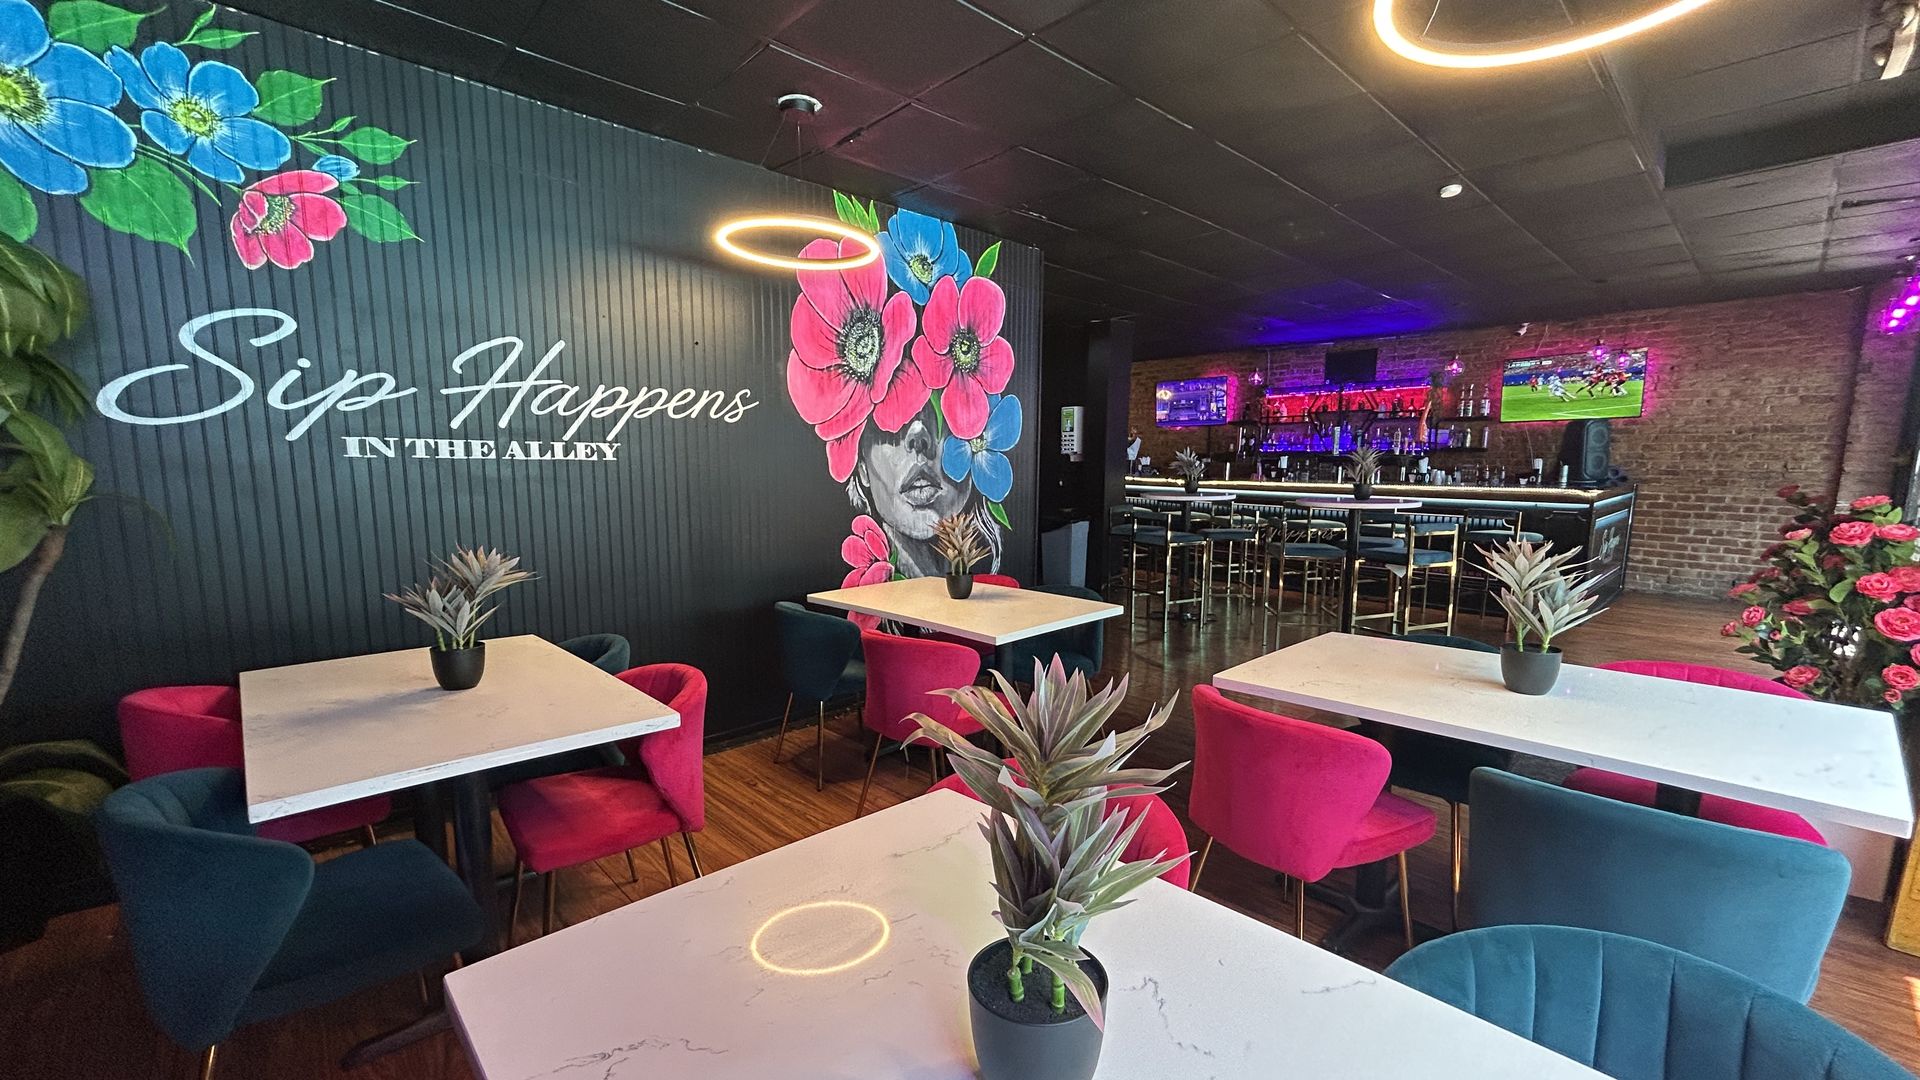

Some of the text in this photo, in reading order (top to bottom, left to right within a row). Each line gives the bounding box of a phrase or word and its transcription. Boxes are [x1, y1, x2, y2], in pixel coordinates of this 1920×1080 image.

[96, 307, 759, 441] Sip Happens
[341, 436, 622, 461] IN THE ALLEY
